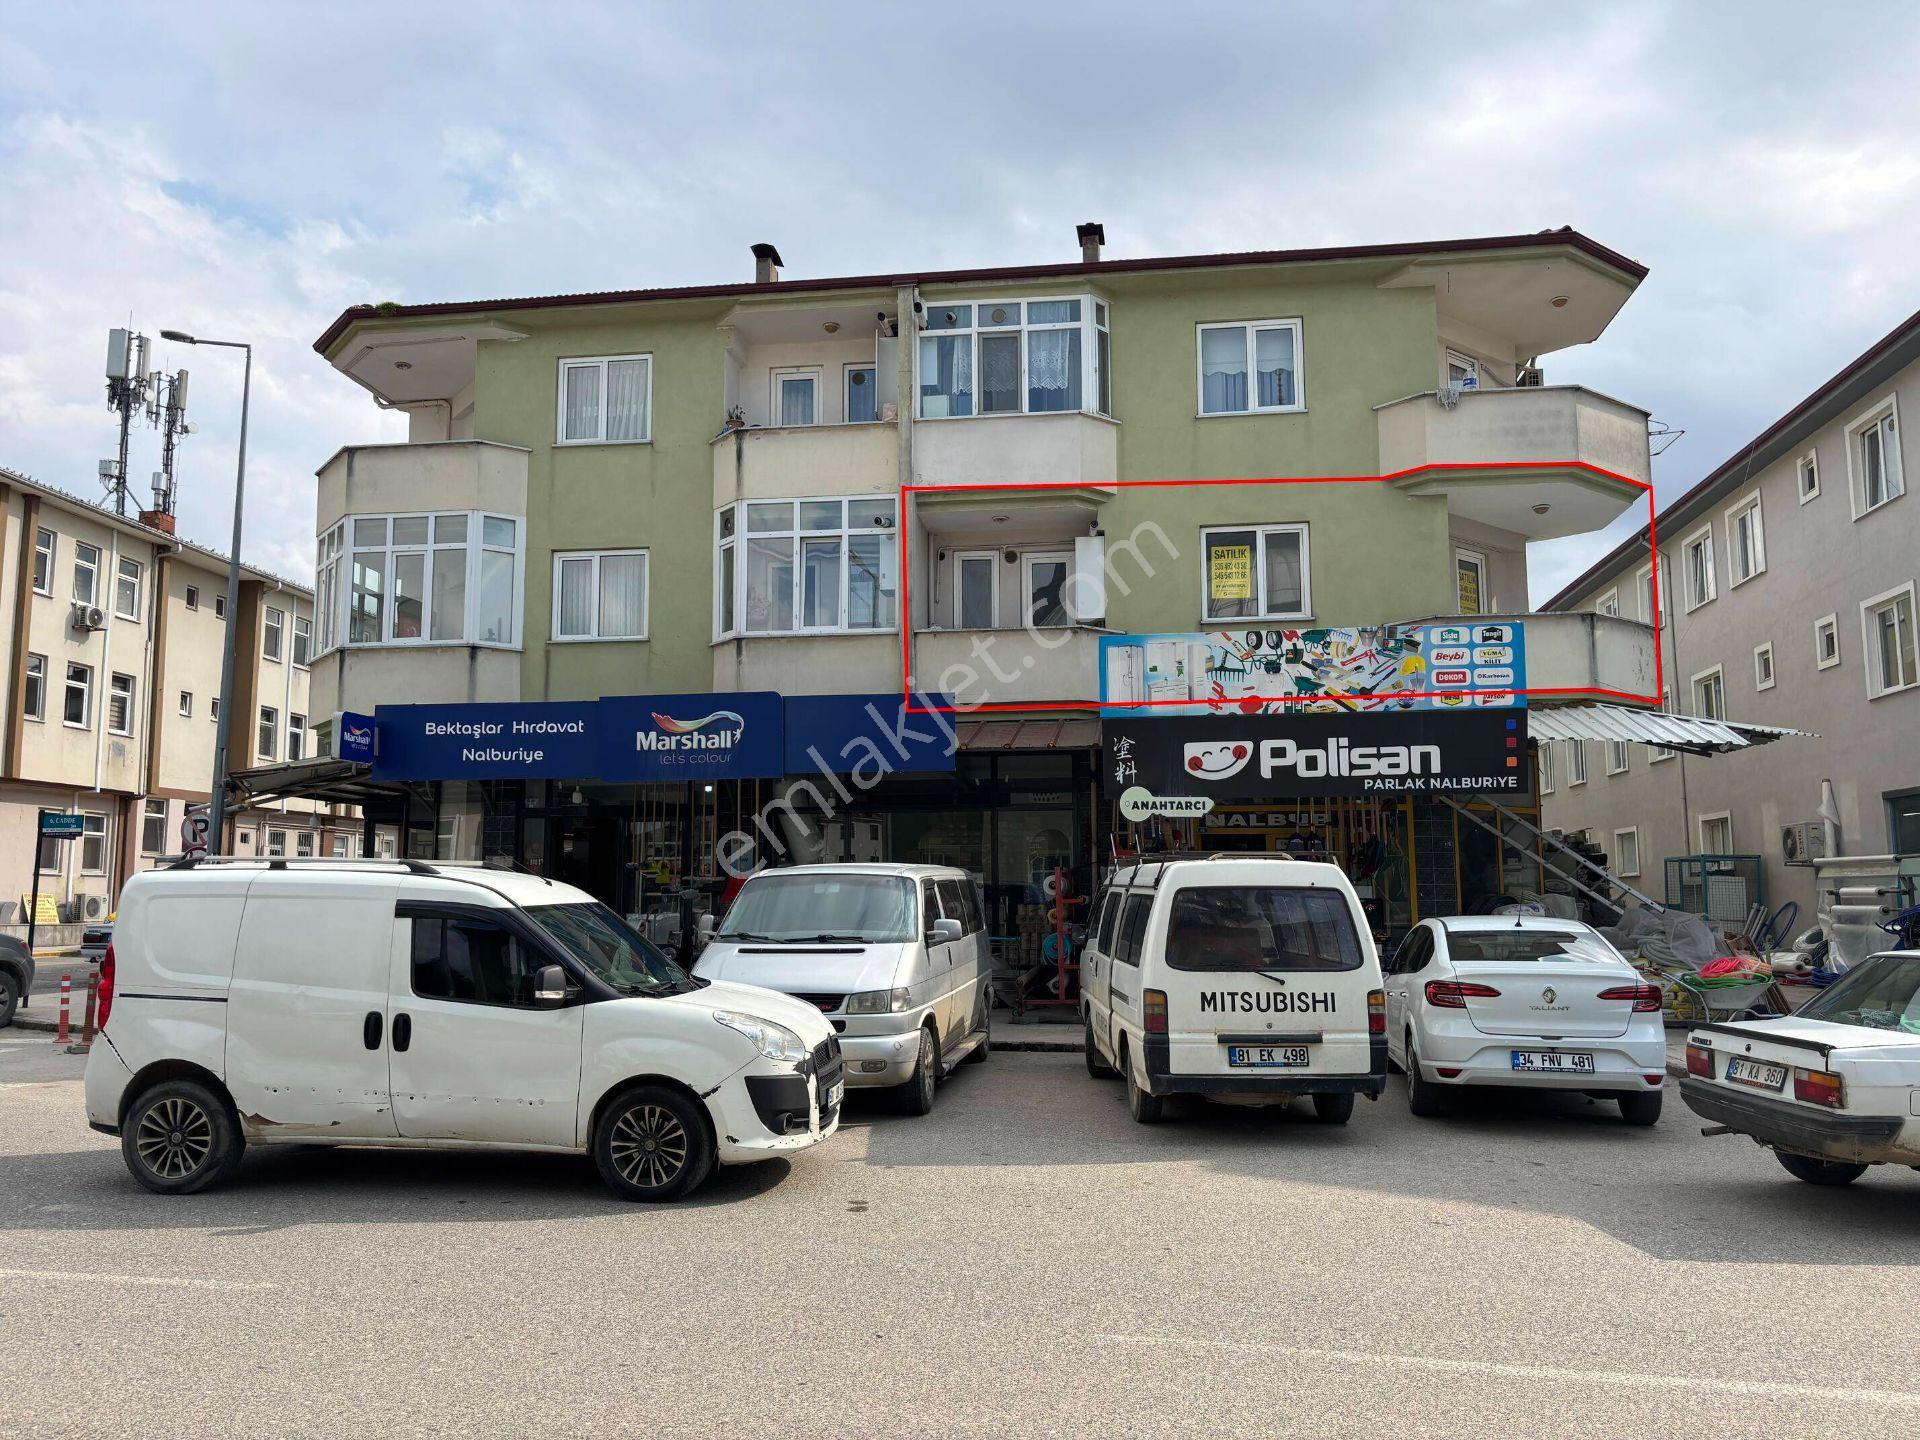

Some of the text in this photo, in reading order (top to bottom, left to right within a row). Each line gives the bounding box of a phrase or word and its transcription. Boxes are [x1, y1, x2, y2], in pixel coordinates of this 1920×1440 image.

[1214, 549, 1247, 559] SATILIK
[1482, 630, 1502, 638] Tangit
[1435, 652, 1465, 661] Beybi
[425, 720, 584, 738] Bektaşlar Hırdavat
[636, 730, 732, 751] Marshall
[462, 748, 544, 763] Nalburiye
[660, 752, 732, 765] let's colour
[1259, 737, 1441, 779] Polisan
[1364, 778, 1425, 790] PARLAK
[1131, 800, 1206, 811] ANAHTARCI
[192, 818, 209, 842] P
[1200, 991, 1336, 1013] MITSUBISHI
[1237, 1049, 1250, 1062] 81
[1260, 1049, 1275, 1062] EK
[1283, 1049, 1306, 1062] 498
[1520, 1053, 1534, 1066] 34
[1541, 1054, 1562, 1067] FNV
[1571, 1055, 1591, 1068] 481
[1733, 1061, 1745, 1076] 81
[1747, 1064, 1760, 1080] KA
[1764, 1068, 1783, 1085] 360
